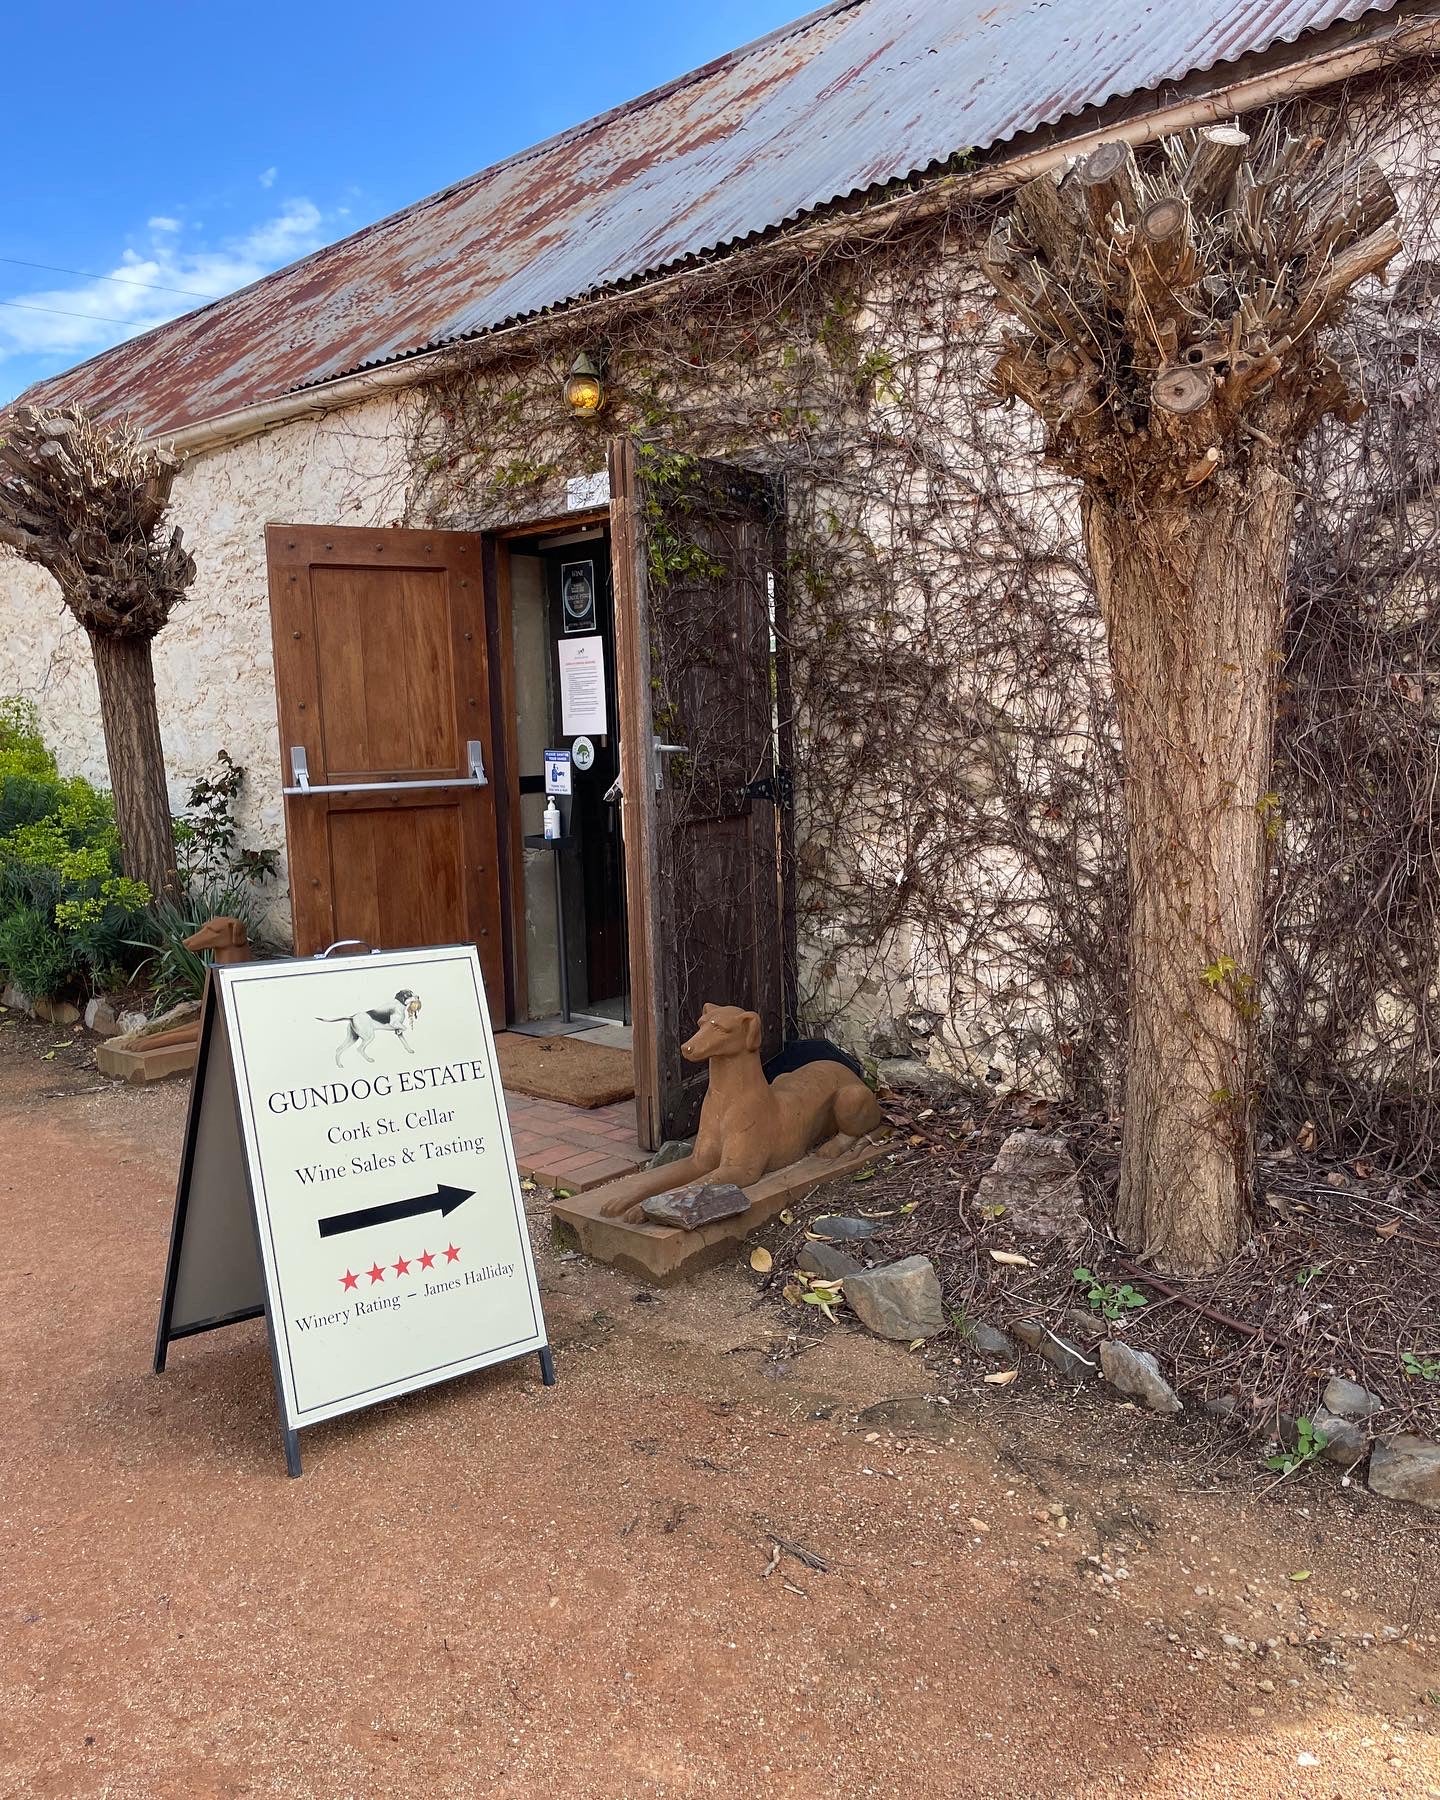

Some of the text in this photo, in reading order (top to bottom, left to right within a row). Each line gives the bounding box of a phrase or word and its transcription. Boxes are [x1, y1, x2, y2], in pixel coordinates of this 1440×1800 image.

[268, 1060, 486, 1114] GUNDOG ESTATE
[327, 1108, 456, 1145] Cork St. Cellar
[294, 1135, 486, 1185] Wine Sales & Tasting
[295, 1308, 350, 1333] Winery
[354, 1294, 402, 1317] Rating
[423, 1278, 461, 1297] James
[464, 1262, 515, 1285] Halliday
